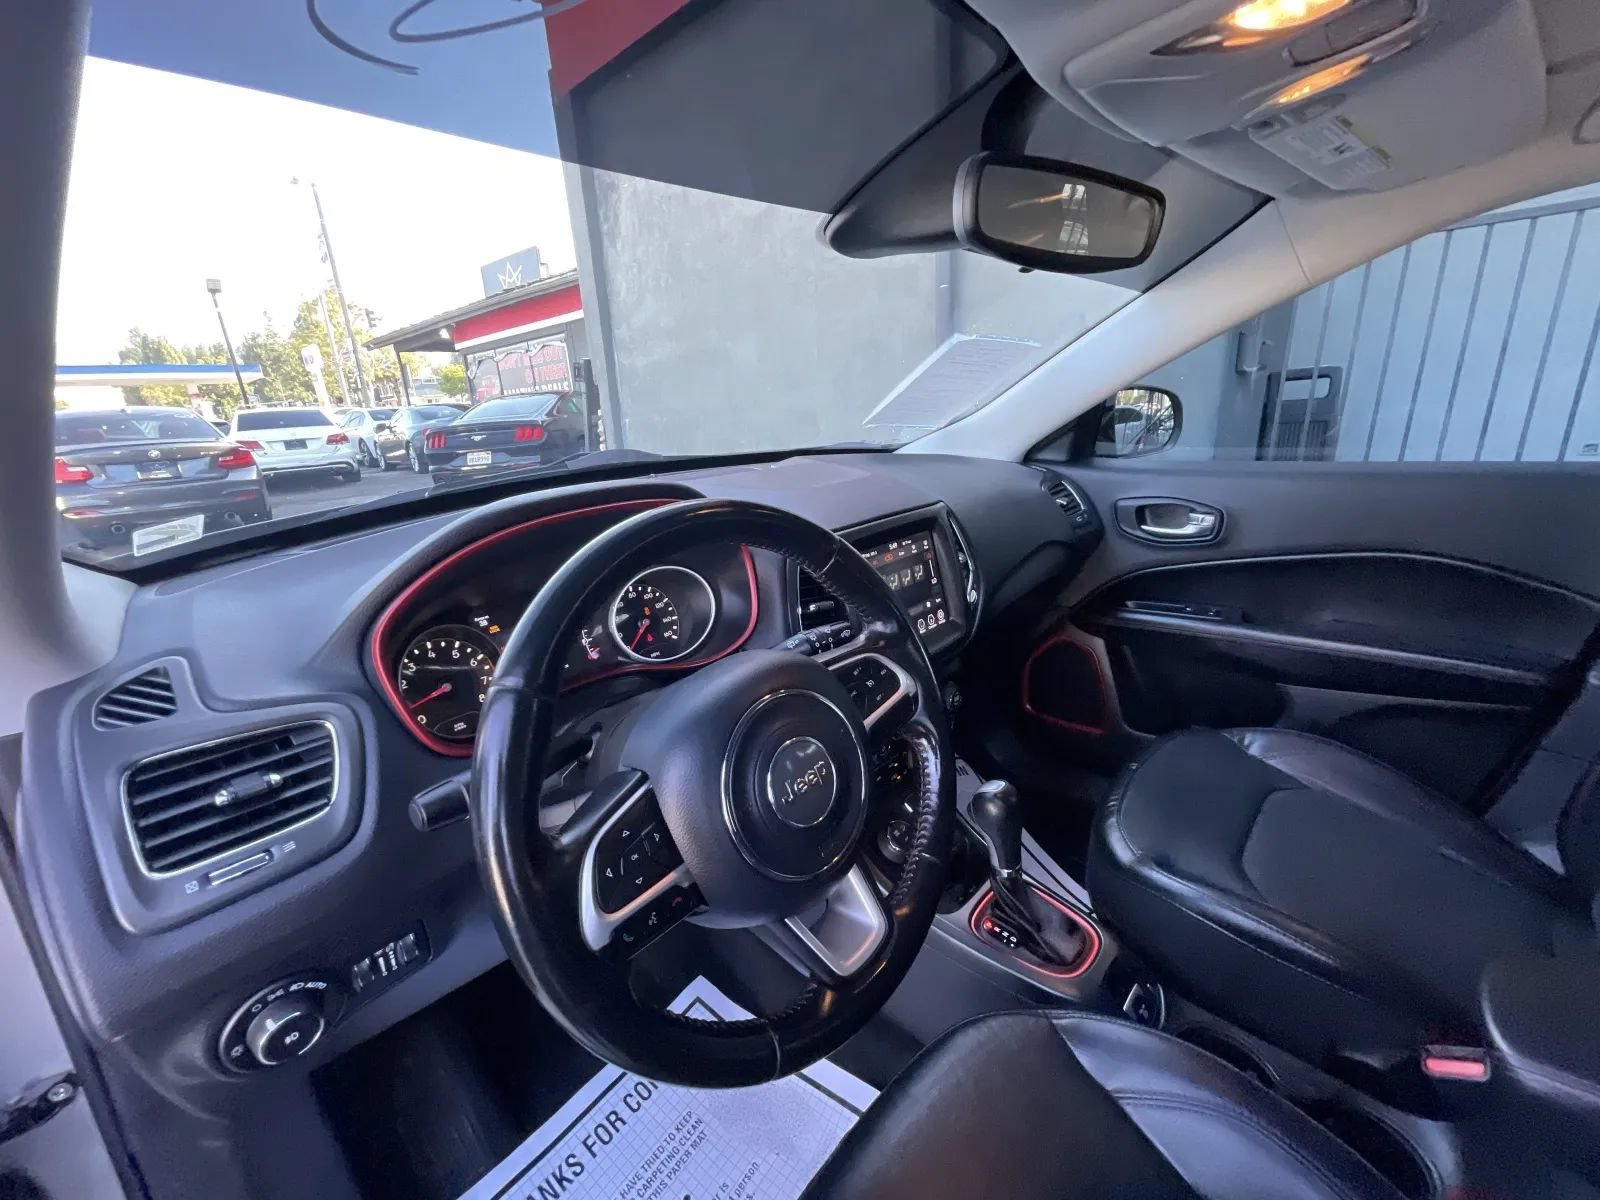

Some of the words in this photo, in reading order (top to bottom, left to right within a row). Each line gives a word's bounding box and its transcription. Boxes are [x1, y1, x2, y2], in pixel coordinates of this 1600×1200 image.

[655, 601, 665, 609] 120
[664, 630, 673, 638] 160
[428, 650, 437, 659] 4
[452, 650, 460, 659] 5
[408, 662, 417, 672] 3
[470, 658, 478, 667] 6
[480, 675, 488, 685] 7
[479, 693, 486, 703] 8
[417, 715, 427, 725] 0
[781, 761, 826, 805] Jeep
[582, 1110, 627, 1159] FOR
[620, 1173, 643, 1200] HAVE
[641, 1146, 665, 1174] TRIED
[664, 1132, 676, 1146] TO
[675, 1110, 694, 1134] KEEP
[637, 1147, 680, 1198] CARPETING
[679, 1117, 704, 1148] CLEAN
[647, 1180, 669, 1200] THIS
[667, 1150, 692, 1181] PAPER
[692, 1131, 708, 1151] MAT
[734, 1161, 760, 1198] person
[719, 1181, 730, 1193] is
